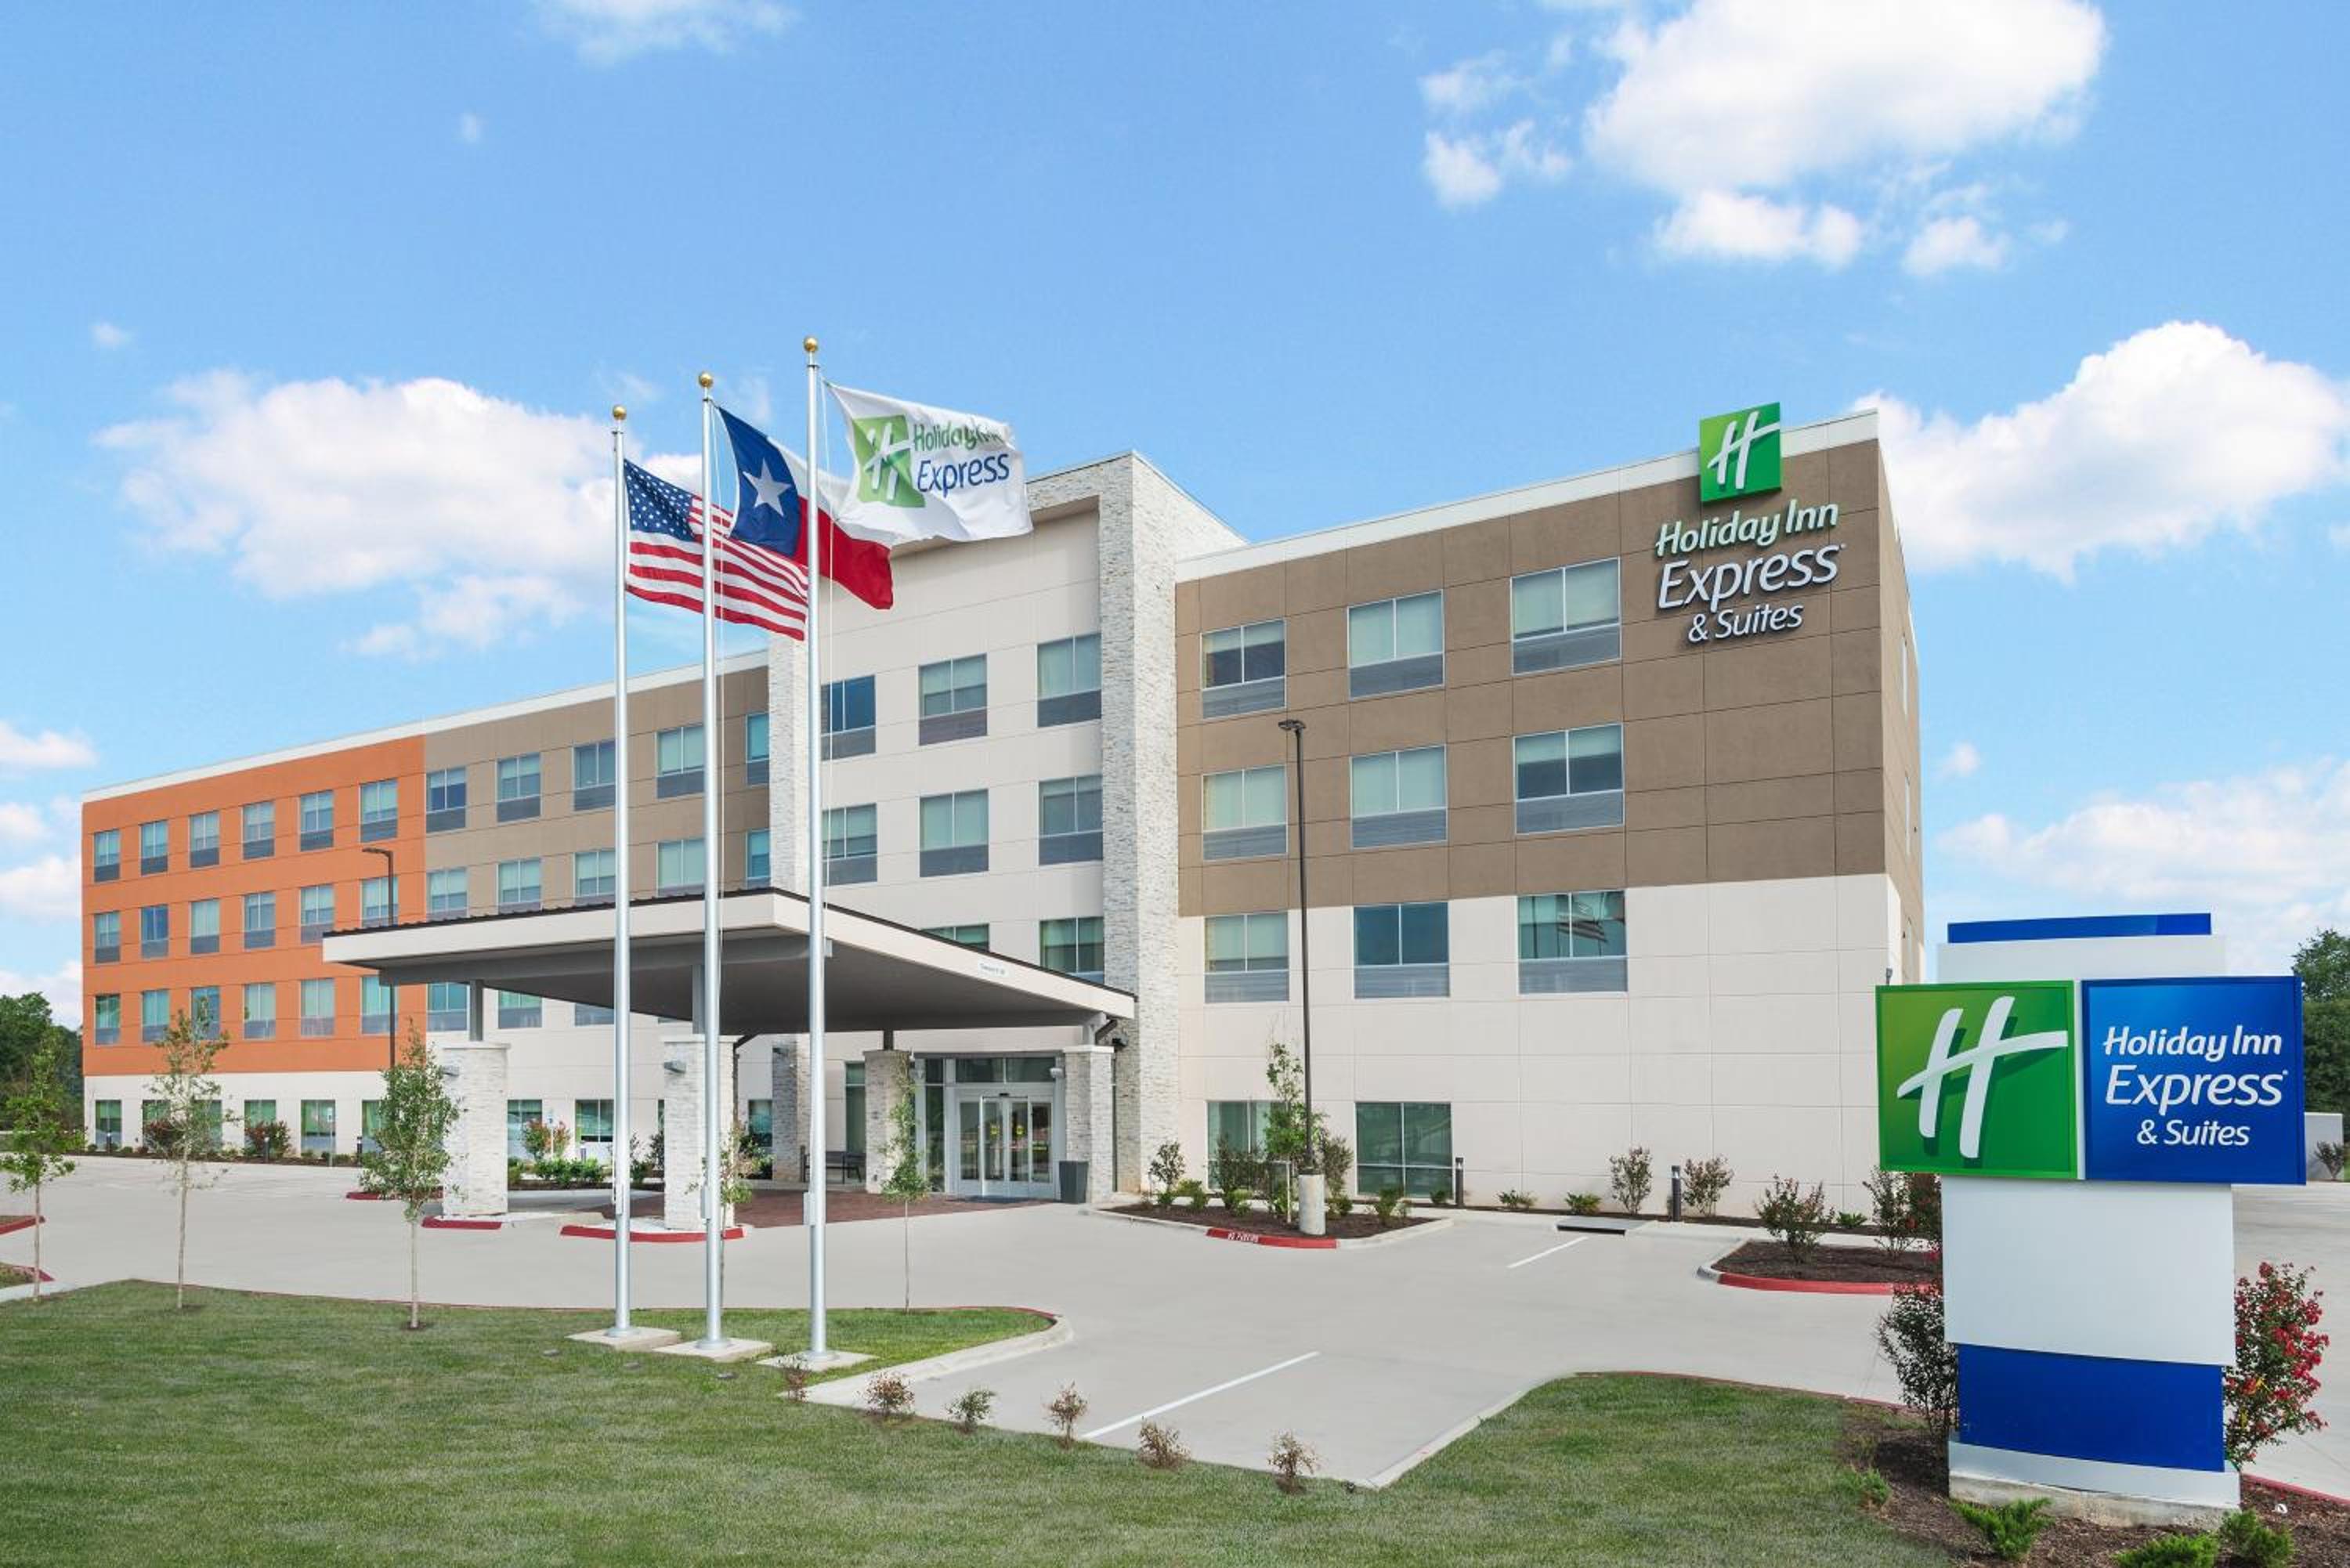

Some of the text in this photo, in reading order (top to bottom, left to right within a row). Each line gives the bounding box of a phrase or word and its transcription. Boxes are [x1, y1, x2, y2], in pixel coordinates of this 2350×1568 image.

[913, 421, 976, 451] Holiday
[917, 453, 1010, 498] Express
[1655, 499, 1838, 557] Holiday Inn
[1658, 544, 1840, 612] Express
[1688, 604, 1804, 642] & Suites
[2103, 1024, 2282, 1062] Holiday Inn
[2105, 1064, 2283, 1115] Express
[2136, 1120, 2251, 1147] & Suites
